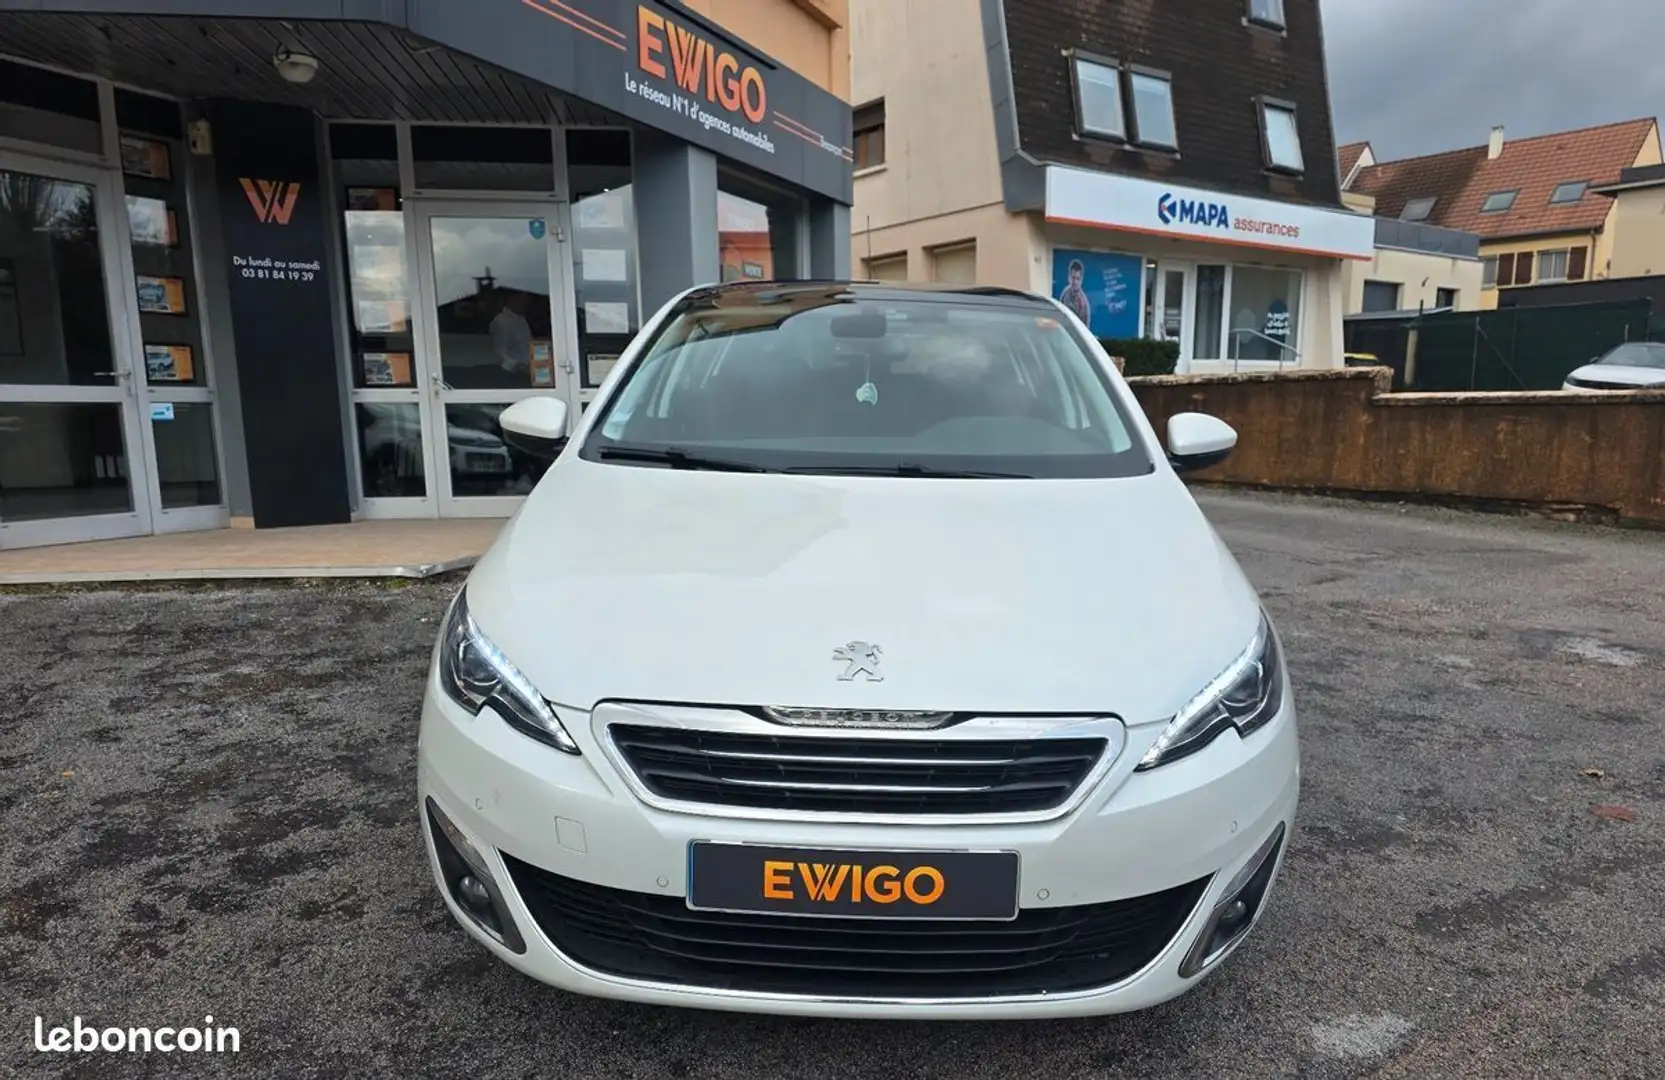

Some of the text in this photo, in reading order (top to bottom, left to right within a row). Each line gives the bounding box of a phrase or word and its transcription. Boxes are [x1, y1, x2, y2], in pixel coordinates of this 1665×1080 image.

[637, 4, 767, 124] EWIGO
[624, 72, 637, 93] Le
[639, 80, 671, 108] réseau
[731, 124, 775, 154] automobiles
[1179, 198, 1300, 238] MAPA assurances
[233, 255, 320, 271] Du lundi au samedi
[241, 268, 255, 278] 03
[257, 269, 269, 279] 81
[272, 270, 285, 280] 84
[287, 271, 300, 281] 19
[763, 860, 945, 905] EWIGO
